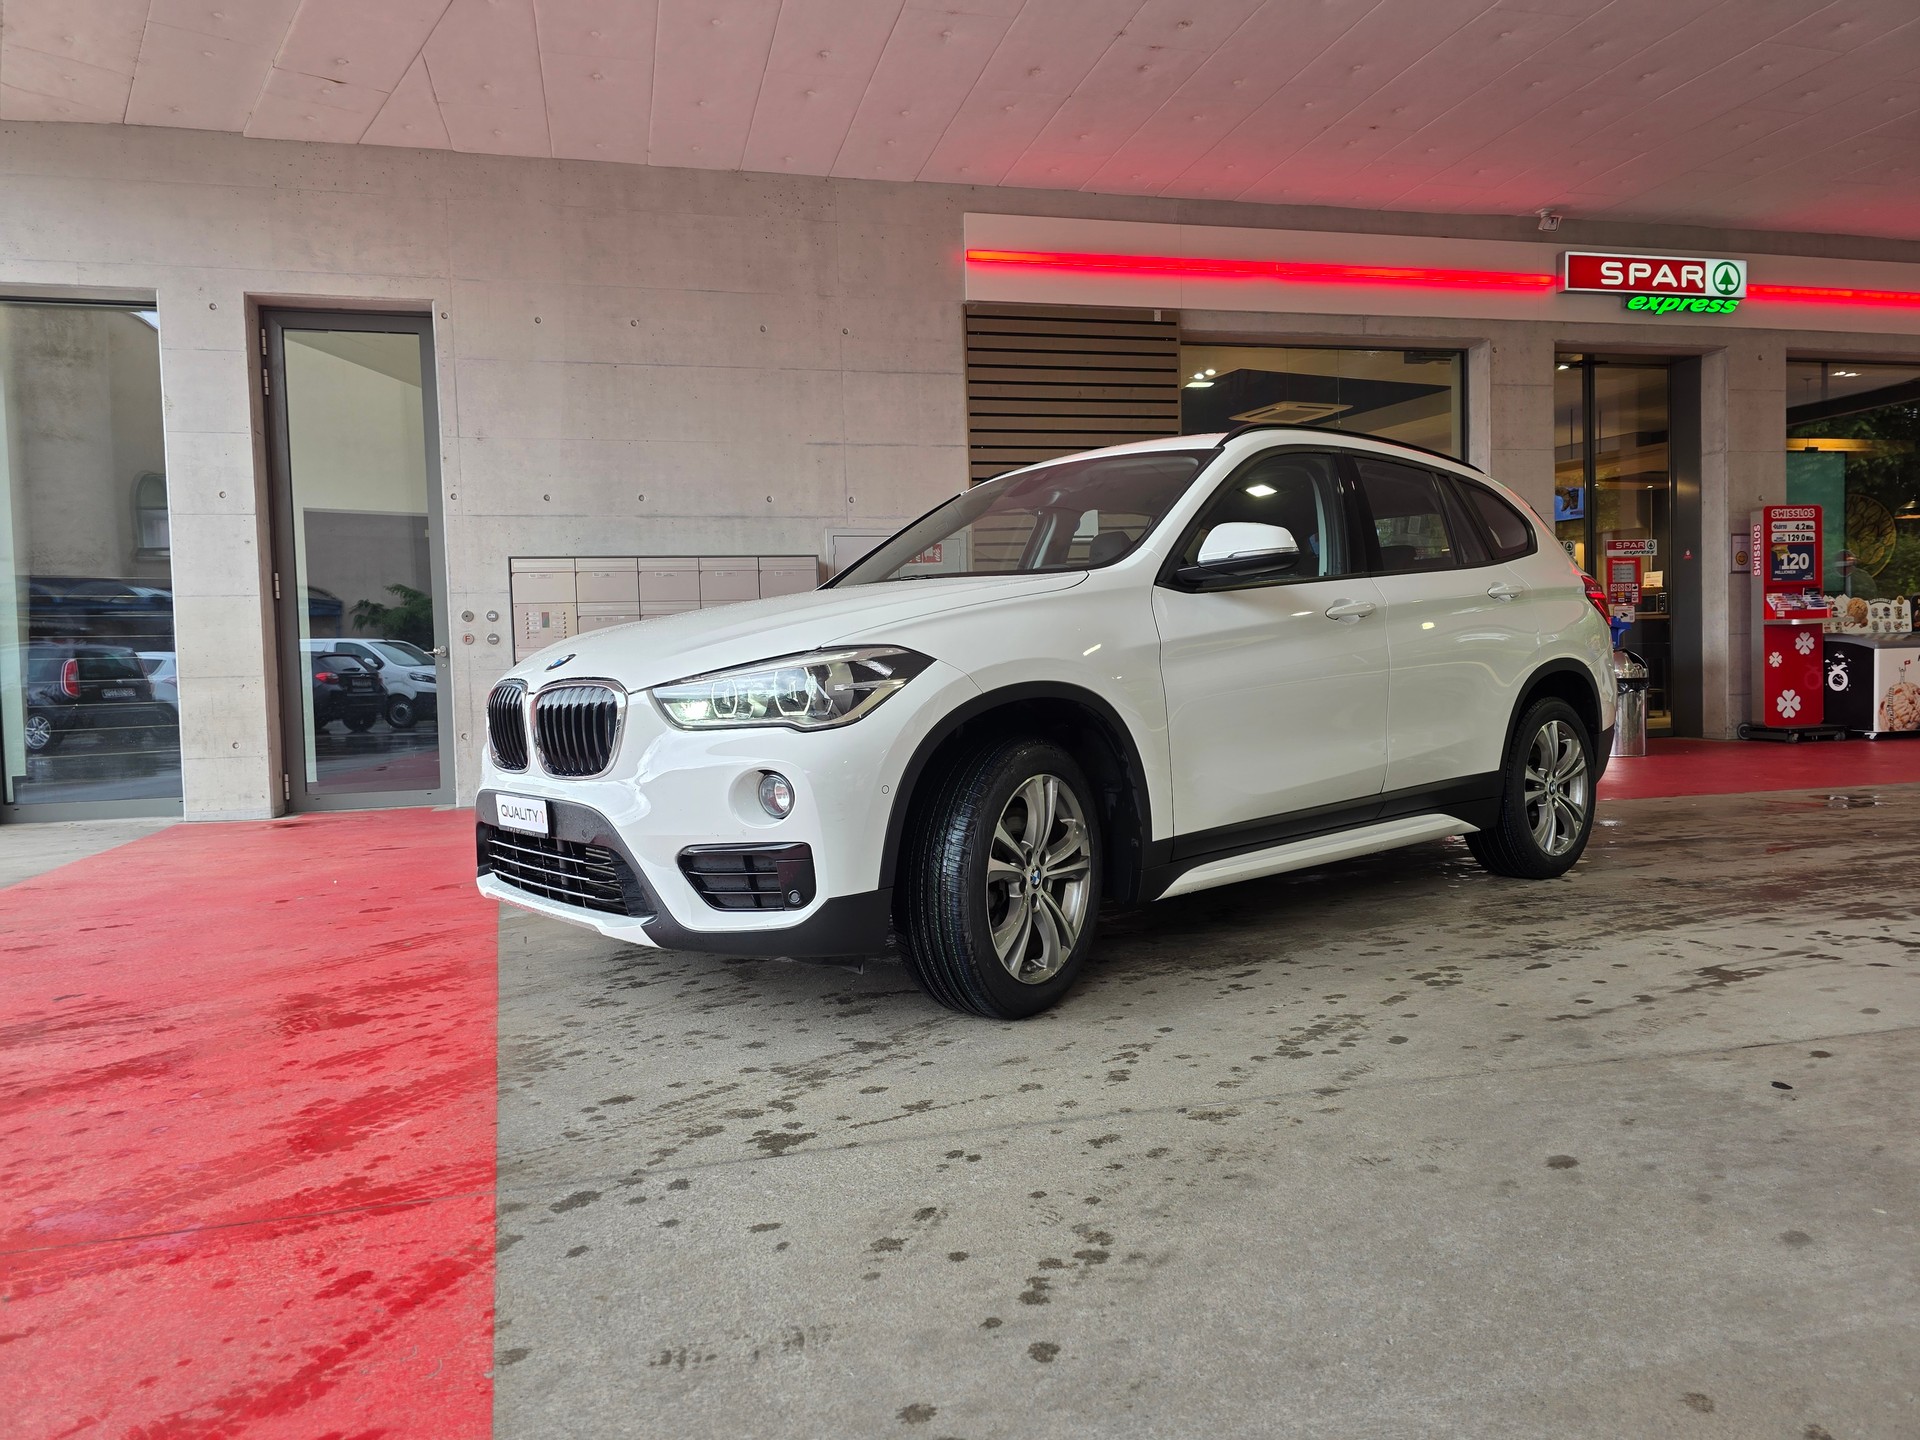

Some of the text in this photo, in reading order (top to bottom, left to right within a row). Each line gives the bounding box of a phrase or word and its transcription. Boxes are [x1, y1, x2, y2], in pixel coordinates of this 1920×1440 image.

[1600, 261, 1704, 289] SPAR
[1626, 295, 1740, 315] express
[1772, 509, 1815, 518] SWISSLOS
[1795, 523, 1806, 531] 4.2
[1615, 541, 1645, 549] SPAR
[1753, 524, 1761, 576] SWISSLOS
[1781, 553, 1809, 570] 120
[465, 635, 471, 643] F
